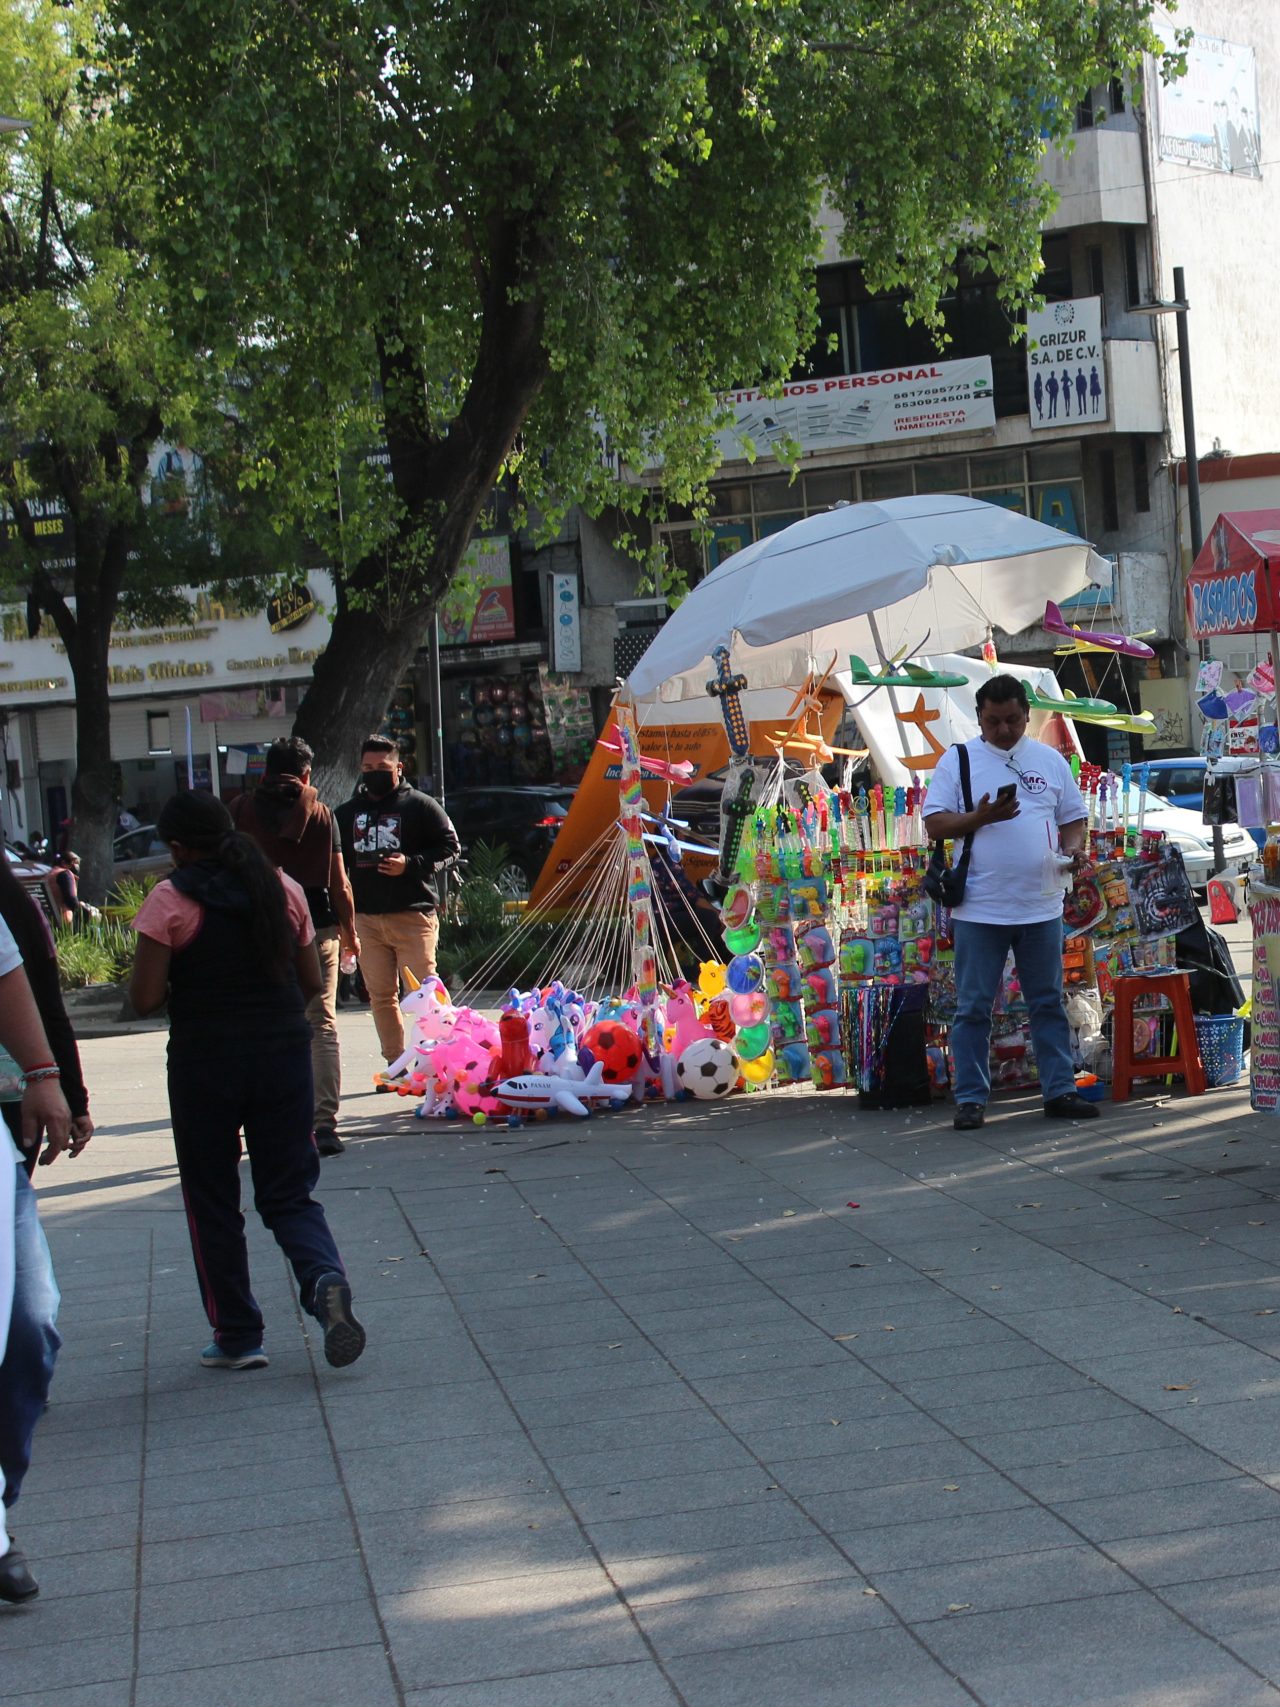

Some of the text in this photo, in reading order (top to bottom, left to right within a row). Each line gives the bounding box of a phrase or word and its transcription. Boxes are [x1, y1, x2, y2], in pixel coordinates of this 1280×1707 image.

[1040, 330, 1086, 347] GRIZUR
[1031, 345, 1100, 365] S.A. DE C.V.
[825, 367, 942, 391] PERSONAL
[34, 520, 64, 536] MESES
[1192, 571, 1257, 633] RASPADOS
